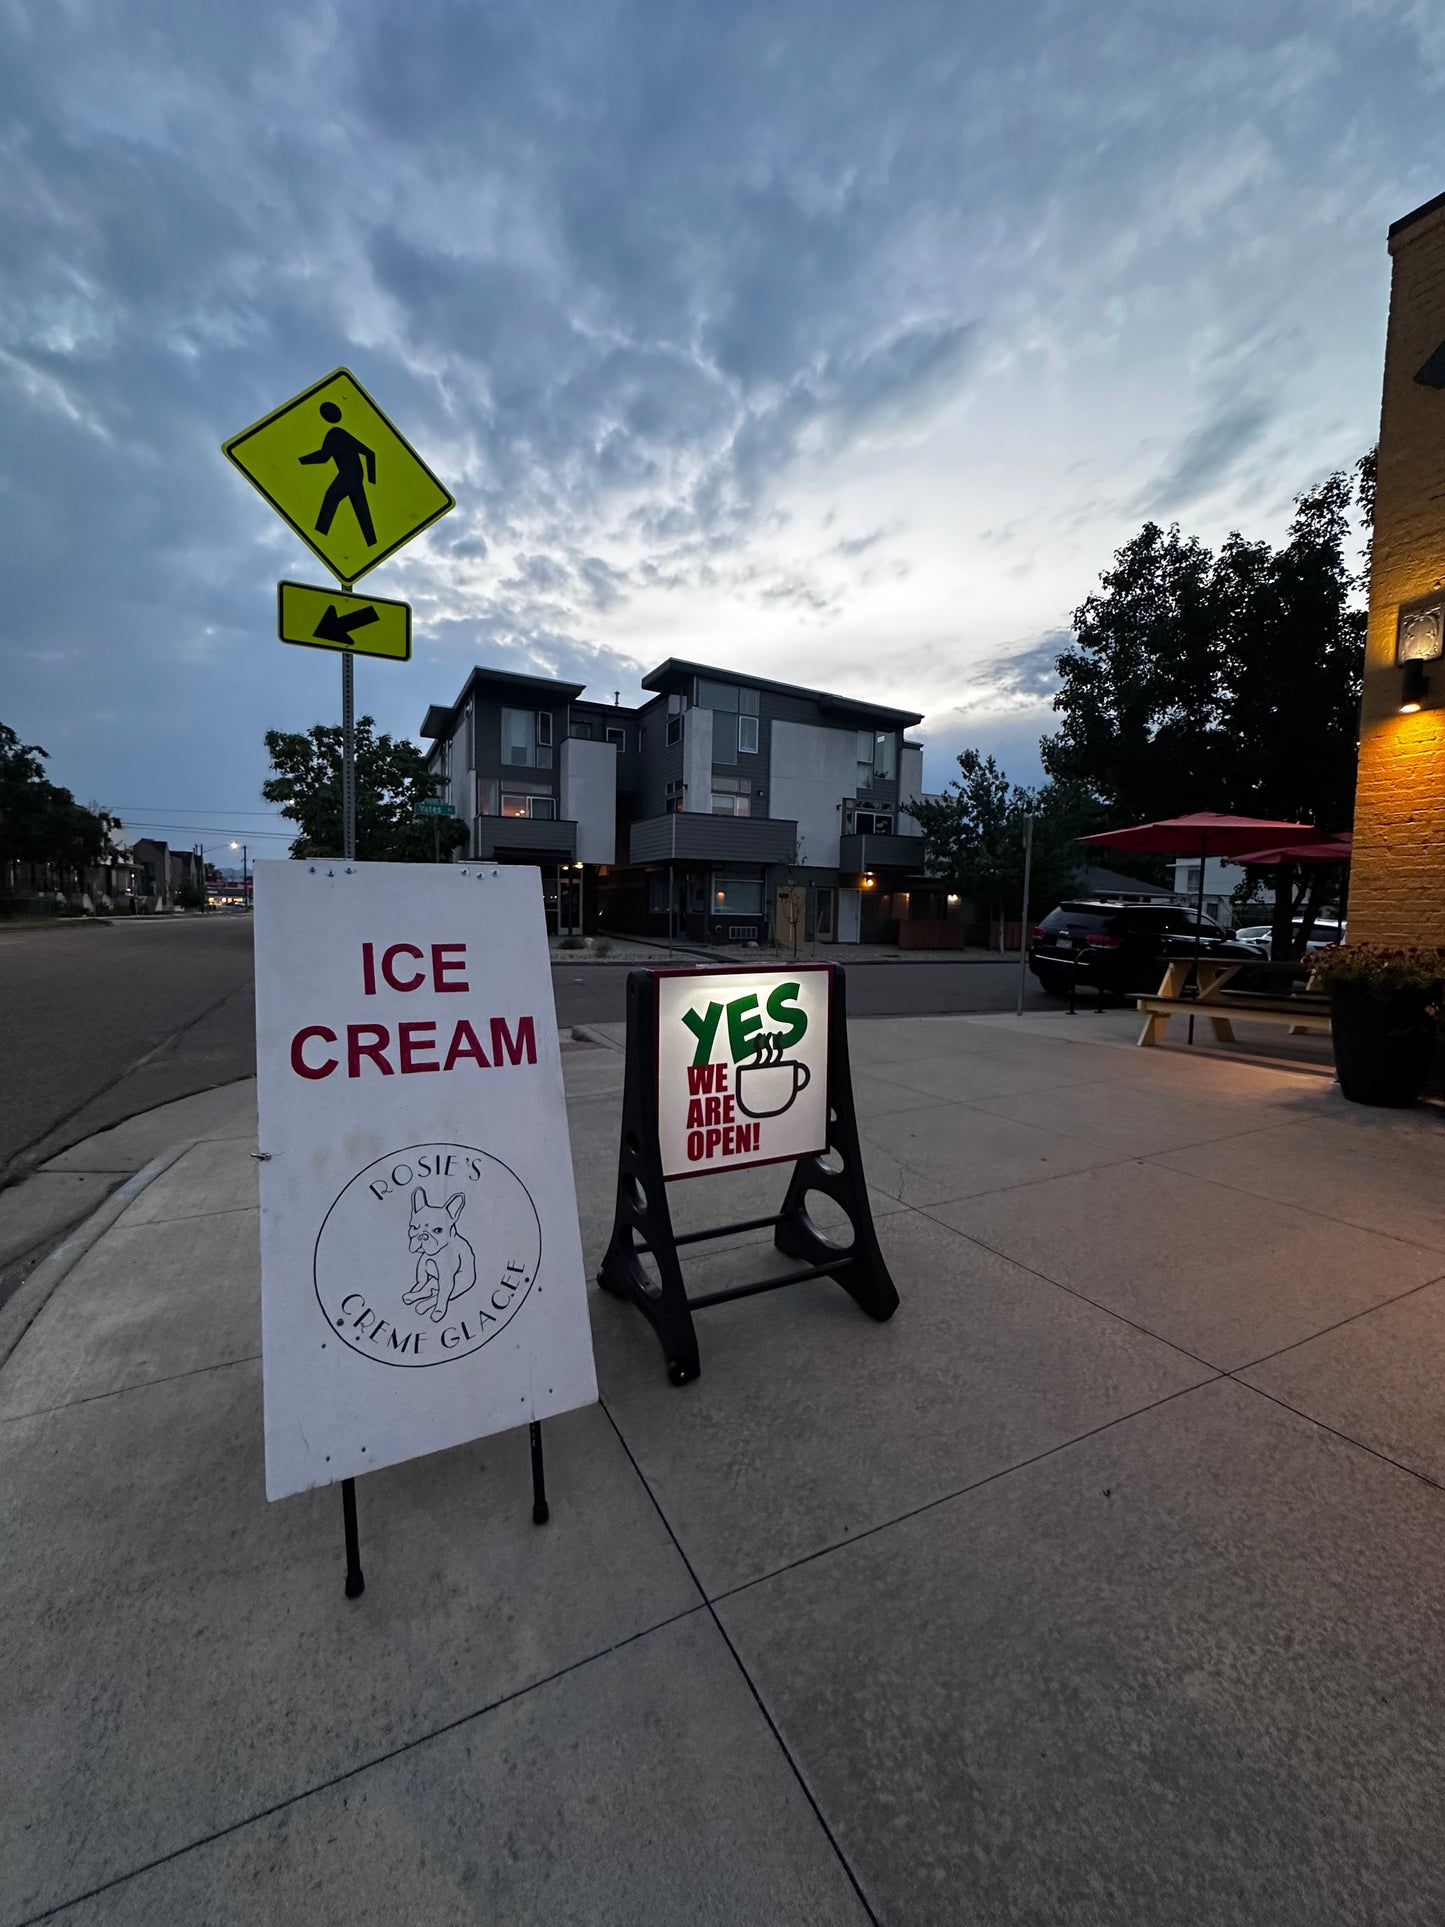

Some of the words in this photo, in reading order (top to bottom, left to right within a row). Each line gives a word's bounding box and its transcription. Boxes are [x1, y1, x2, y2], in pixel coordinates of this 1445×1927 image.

[362, 942, 470, 995] ICE
[290, 1016, 538, 1080] CREAM
[681, 982, 808, 1066] YES
[687, 1062, 728, 1096] WE
[686, 1094, 735, 1129] ARE
[687, 1122, 761, 1161] OPEN!
[369, 1154, 482, 1201] ROSIE'S
[341, 1293, 428, 1355] CREME
